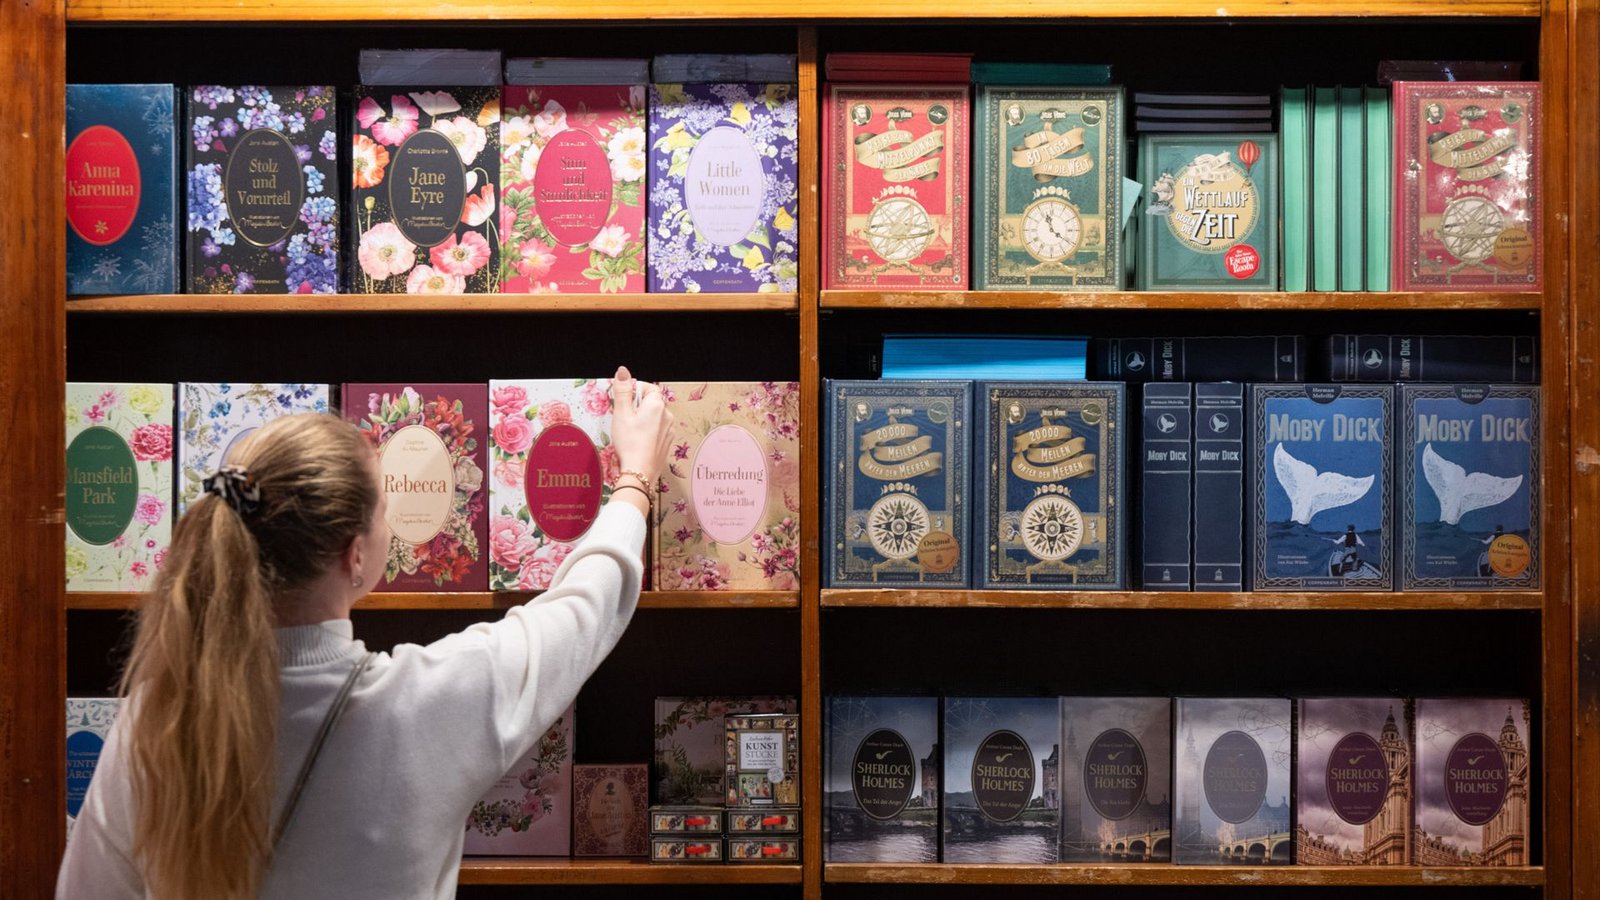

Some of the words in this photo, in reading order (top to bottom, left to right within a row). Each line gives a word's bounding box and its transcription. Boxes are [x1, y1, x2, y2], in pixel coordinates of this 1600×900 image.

[1026, 150, 1041, 165] 80
[82, 162, 120, 178] Anna
[249, 158, 278, 173] Stolz
[707, 160, 742, 177] Little
[1068, 158, 1089, 176] WELT
[252, 174, 276, 189] und
[408, 167, 446, 186] Jane
[562, 172, 585, 186] und
[68, 180, 134, 196] Karenina
[700, 180, 750, 196] Women
[237, 190, 292, 205] Vorurteil
[410, 186, 444, 210] Eyre
[1184, 186, 1248, 211] WETTLAUF
[1190, 209, 1239, 245] ZEIT
[1230, 254, 1254, 266] Escape
[1233, 262, 1254, 273] Room
[1400, 339, 1411, 356] DICK
[1267, 413, 1325, 443] MOBY
[1333, 413, 1381, 442] DICK
[1416, 414, 1474, 443] MOBY
[1481, 414, 1530, 442] DICK
[888, 444, 917, 459] MEILEN
[1041, 445, 1071, 461] MEILEN
[1148, 450, 1168, 461] MOBY
[1170, 450, 1187, 461] DICK
[1200, 450, 1220, 461] MOBY
[1222, 450, 1239, 461] DICK
[67, 466, 132, 484] Mansfield
[696, 464, 763, 484] Überredung
[898, 460, 931, 477] MEEREN
[1018, 462, 1037, 476] UNTER
[1052, 461, 1084, 479] MEEREN
[384, 474, 446, 493] Rebecca
[536, 468, 591, 488] Emma
[83, 487, 116, 504] Park
[714, 487, 725, 495] Die
[726, 487, 744, 495] Liebe
[704, 498, 714, 506] der
[718, 498, 736, 506] Anne
[924, 538, 950, 546] Original
[857, 761, 910, 776] SHERLOCK
[976, 764, 1030, 779] SHERLOCK
[1089, 763, 1143, 775] SHERLOCK
[1330, 768, 1384, 780] SHERLOCK
[1449, 768, 1503, 780] SHERLOCK
[862, 775, 905, 789] HOLMES
[982, 778, 1024, 792] HOLMES
[1095, 776, 1137, 789] HOLMES
[1336, 781, 1380, 793] HOLMES
[1455, 782, 1498, 793] HOLMES
